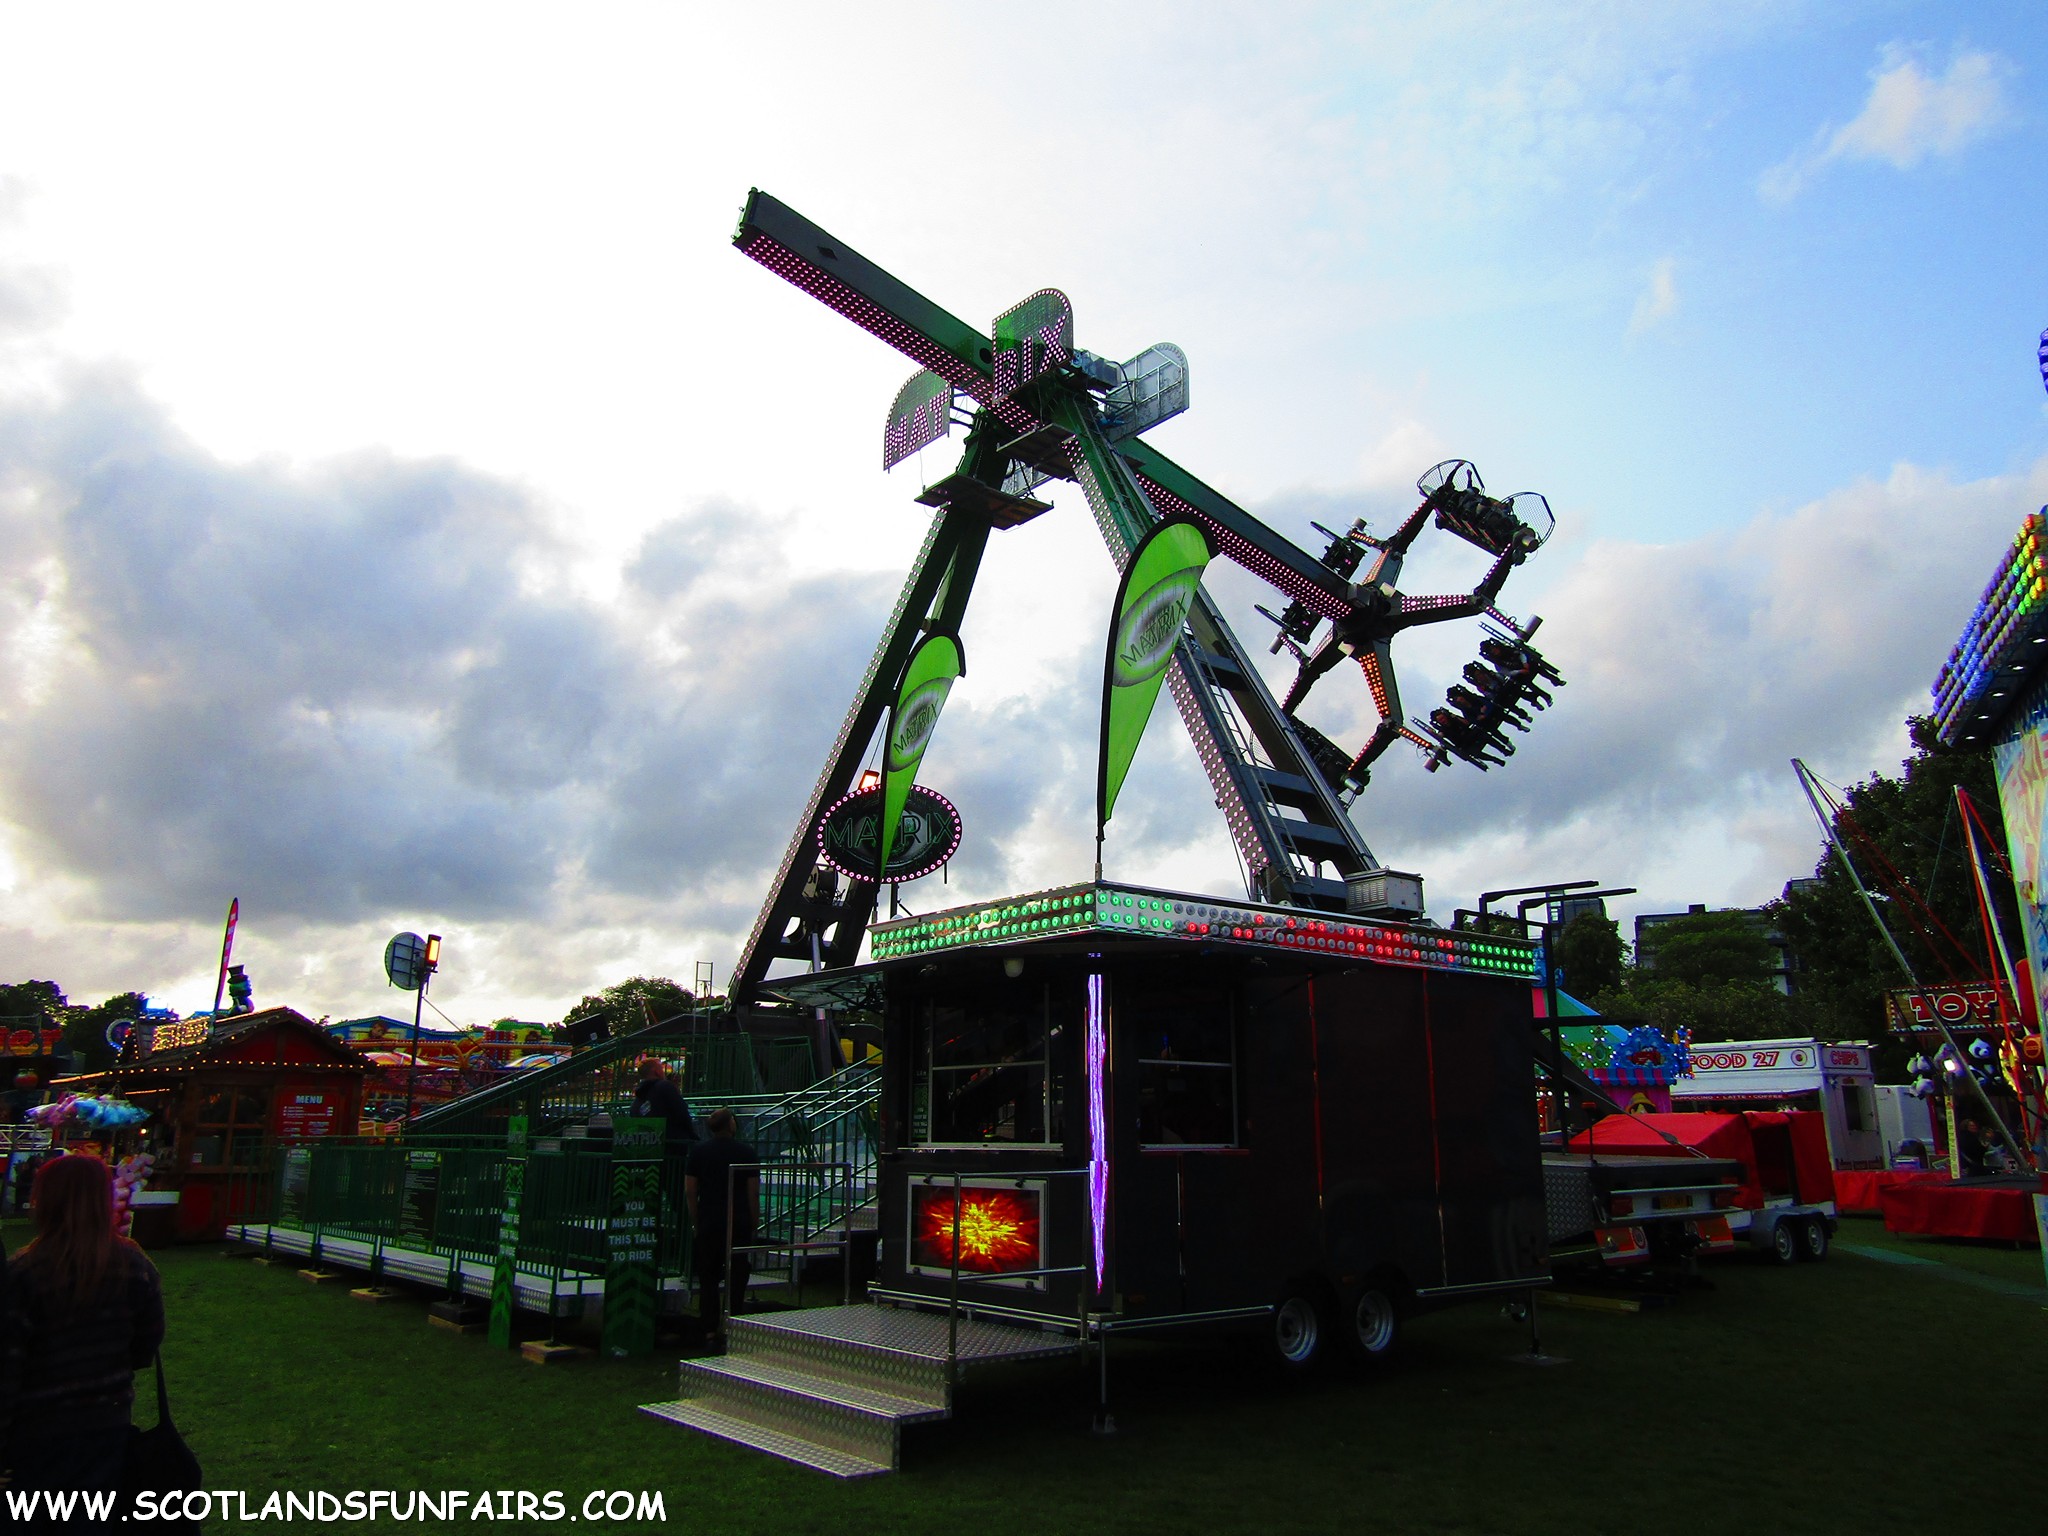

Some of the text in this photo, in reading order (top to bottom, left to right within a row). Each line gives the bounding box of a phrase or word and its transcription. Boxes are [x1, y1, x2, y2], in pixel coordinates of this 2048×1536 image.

[1119, 591, 1187, 667] MATRIX
[893, 698, 939, 754] MATRIX
[825, 811, 955, 849] MARIX
[1753, 1051, 1780, 1067] 27
[1830, 1050, 1859, 1066] CHIPS
[296, 1095, 324, 1104] MENU
[624, 1200, 646, 1212] YOU
[611, 1216, 657, 1230] MUST BE
[608, 1233, 658, 1246] THIS TALL
[612, 1250, 653, 1262] TO RIDE
